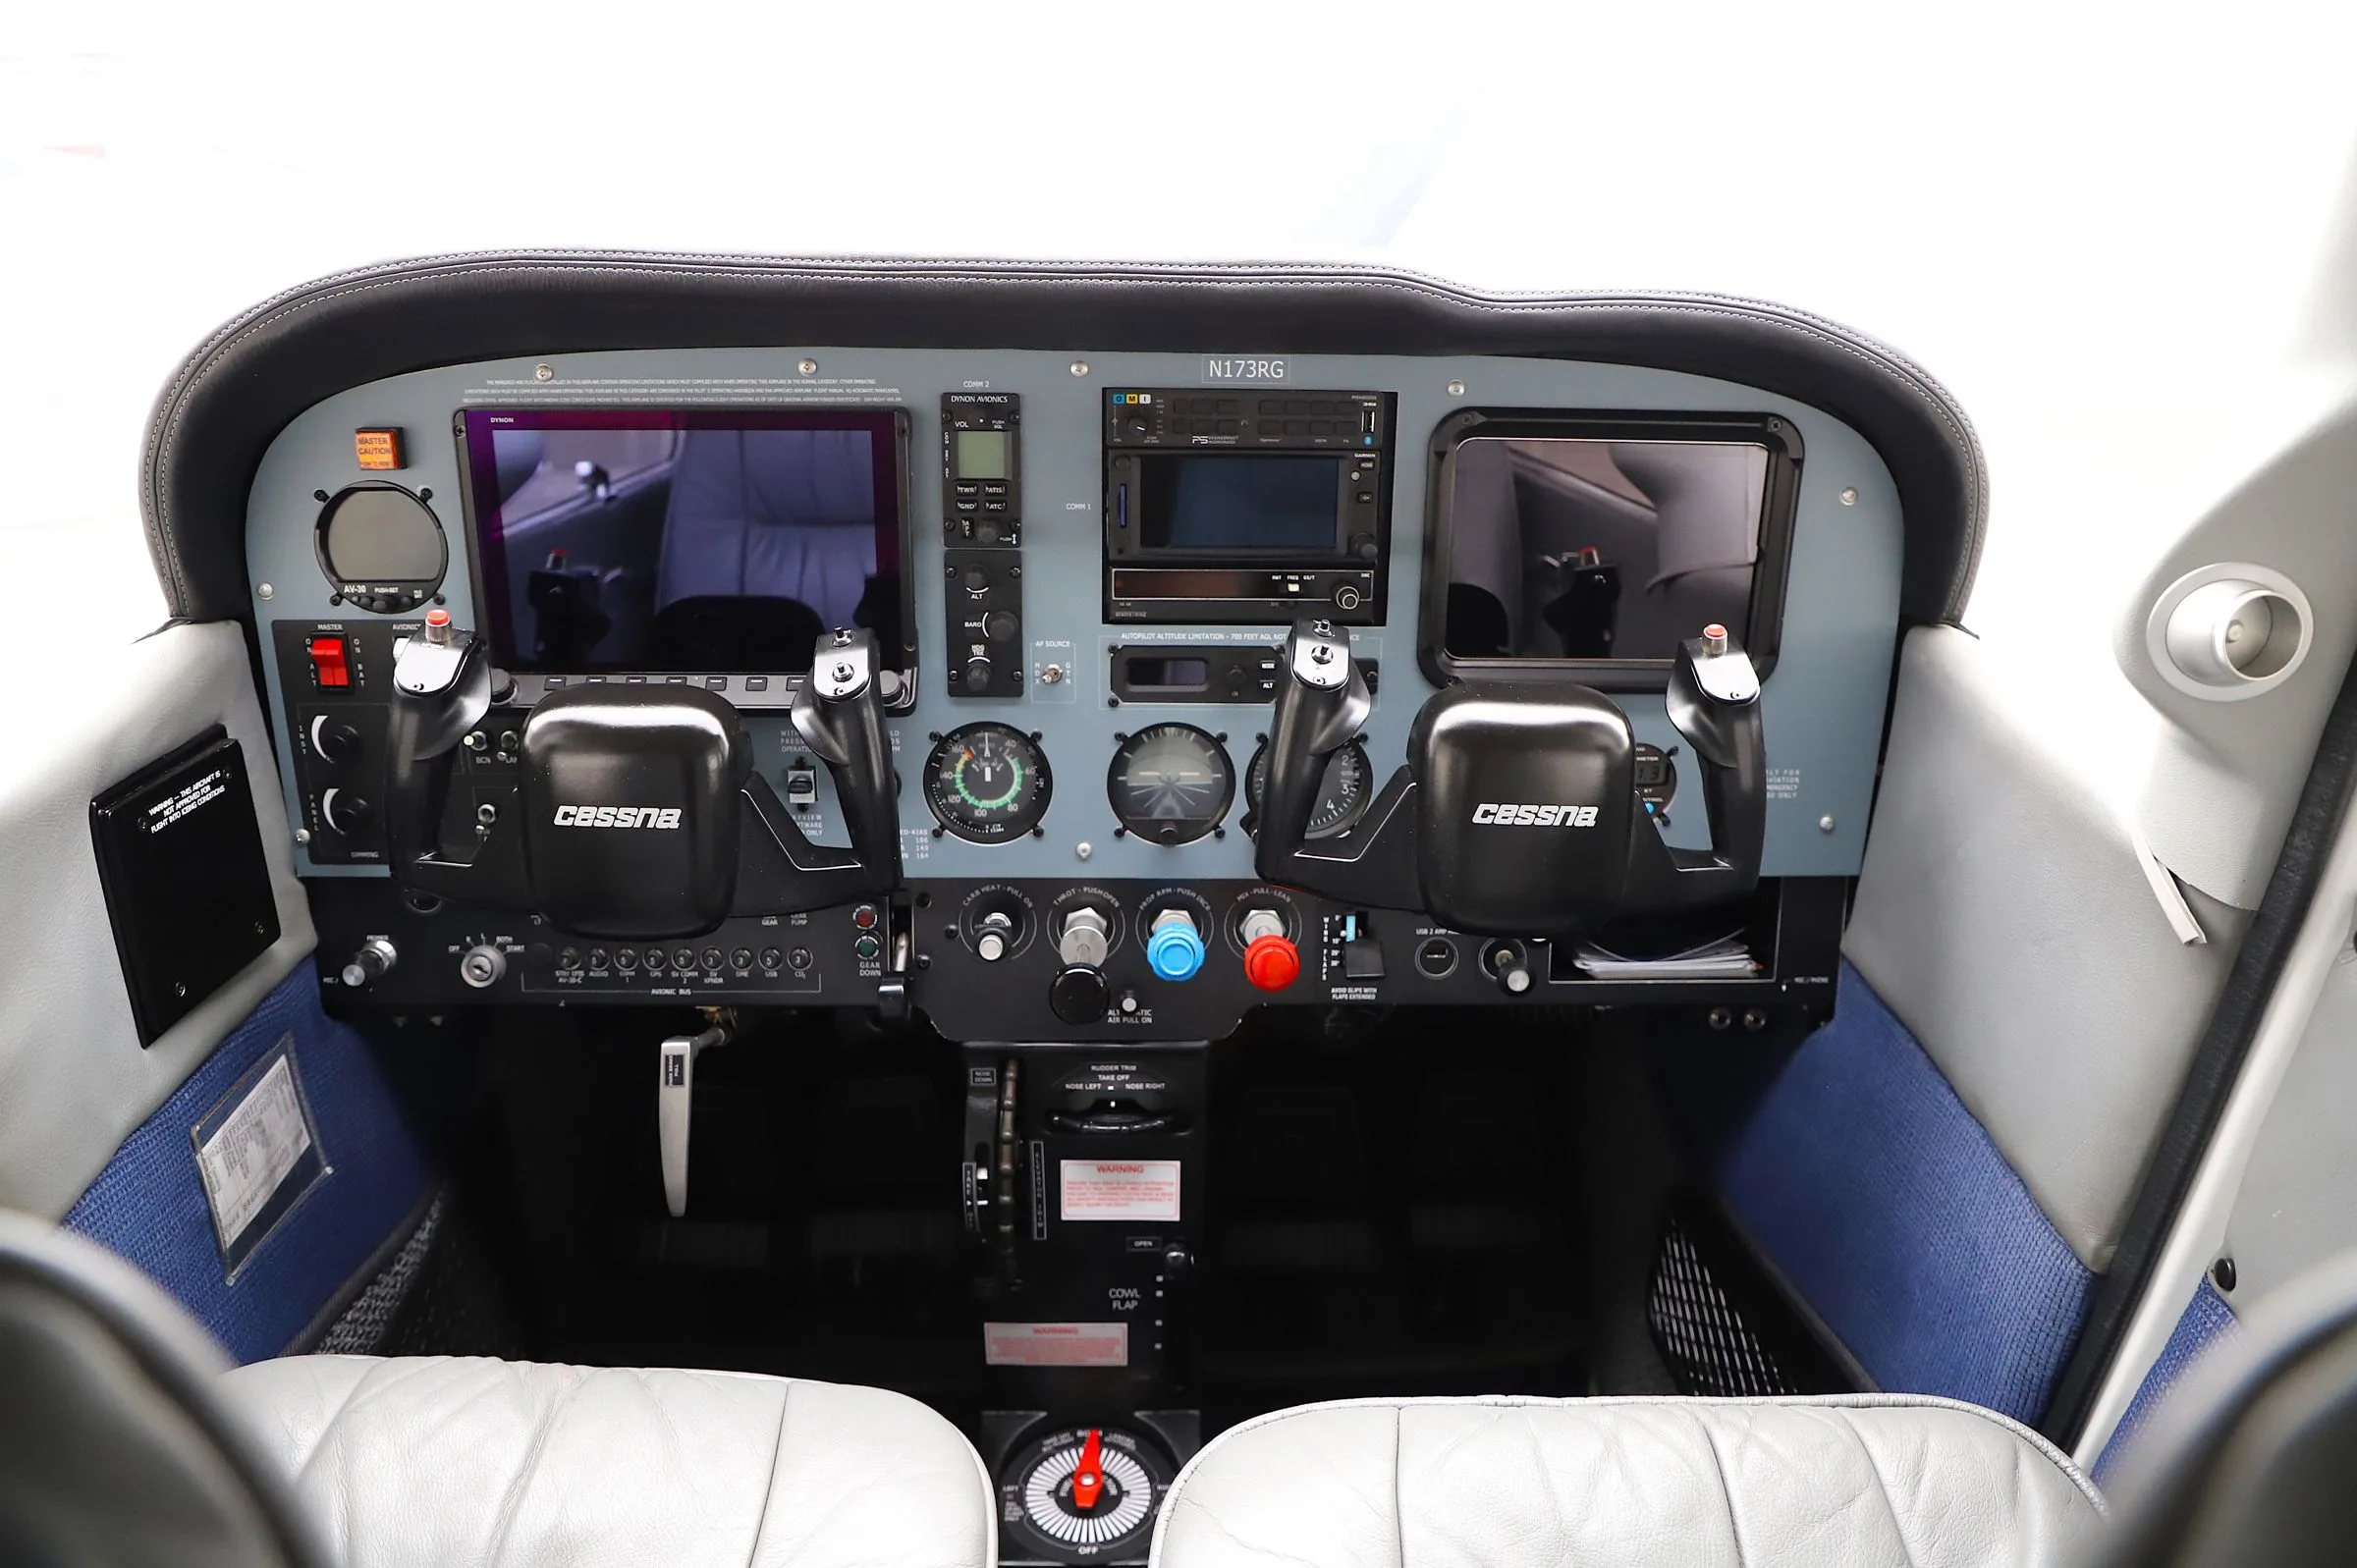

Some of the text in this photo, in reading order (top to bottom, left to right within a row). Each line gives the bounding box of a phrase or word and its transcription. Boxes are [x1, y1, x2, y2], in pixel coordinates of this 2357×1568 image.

[1209, 359, 1284, 378] N173RG
[344, 585, 367, 593] AV-30
[354, 639, 360, 653] ON
[149, 770, 221, 816] WARNING THIS AIRCRAFT IS
[163, 784, 211, 817] NOT APPROVED FOR
[151, 818, 168, 834] FLIGHT
[169, 811, 181, 823] INTO
[197, 785, 225, 805] CONDITIONS
[310, 794, 318, 831] PANEL
[963, 885, 1033, 908] CARB HEAT PULL ON
[1053, 888, 1076, 906] THROT
[1139, 894, 1155, 910] PROP
[1157, 888, 1172, 896] RPM
[1177, 888, 1196, 897] PUSH
[1275, 890, 1291, 903] LEAN
[1096, 1165, 1145, 1173] WARNING
[1109, 1288, 1141, 1298] COWL
[1113, 1301, 1138, 1310] FLAP
